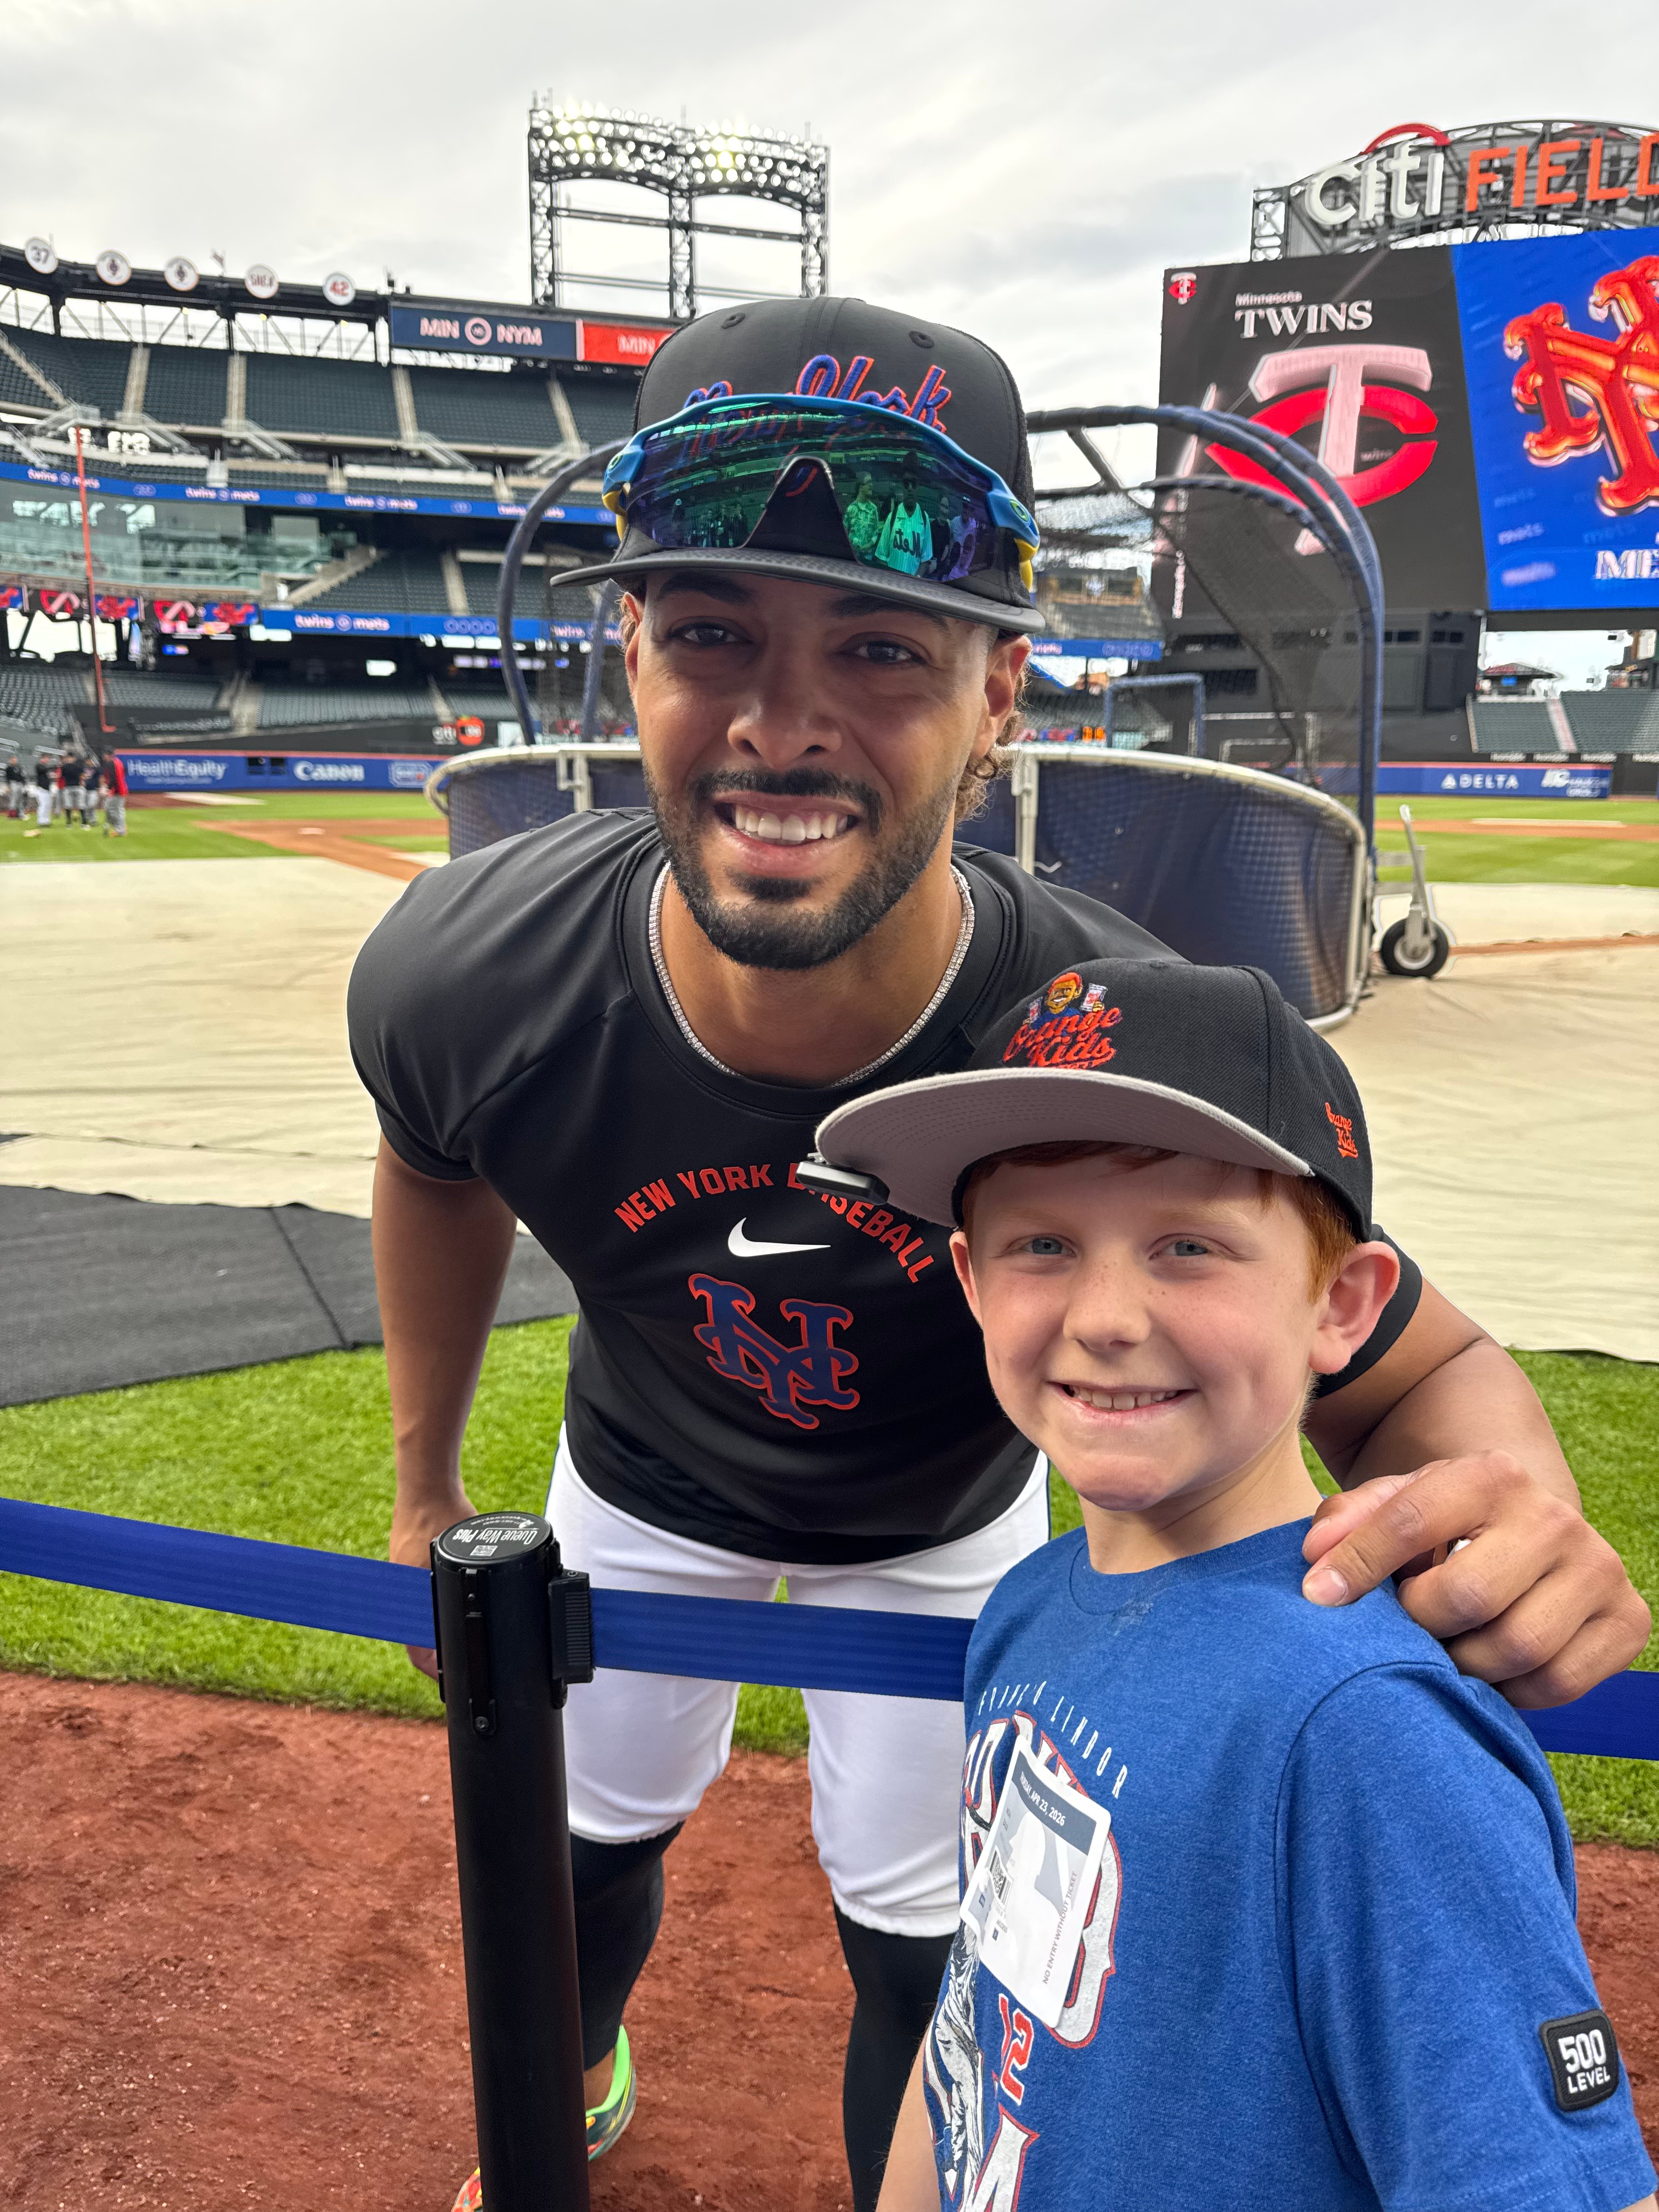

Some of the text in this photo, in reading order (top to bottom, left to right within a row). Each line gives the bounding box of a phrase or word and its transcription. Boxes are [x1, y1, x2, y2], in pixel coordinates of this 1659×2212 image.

[1305, 142, 1444, 225] citi
[31, 247, 49, 264] 37
[330, 281, 349, 297] 42
[420, 318, 543, 346] MIN NYM
[1235, 300, 1372, 339] TWINS
[618, 335, 656, 354] MIN
[295, 614, 390, 631] twins mets
[294, 761, 365, 781] Canon
[1459, 774, 1520, 789] DELTA
[1003, 1007, 1121, 1062] Orange
[1028, 1033, 1116, 1067] Kids
[614, 1179, 676, 1233] NEW
[677, 1164, 774, 1199] YORK
[453, 1528, 538, 1544] Queue Way Plus
[1031, 1791, 1040, 1806] APR
[1040, 1799, 1048, 1815] 23,
[1049, 1807, 1065, 1826] 2026
[996, 1920, 1008, 1933] ACCESS
[1042, 1871, 1077, 1984] NO ENTRY WITHOUT TICKET
[1558, 2029, 1607, 2074] 500
[1566, 2066, 1611, 2094] LEVEL
